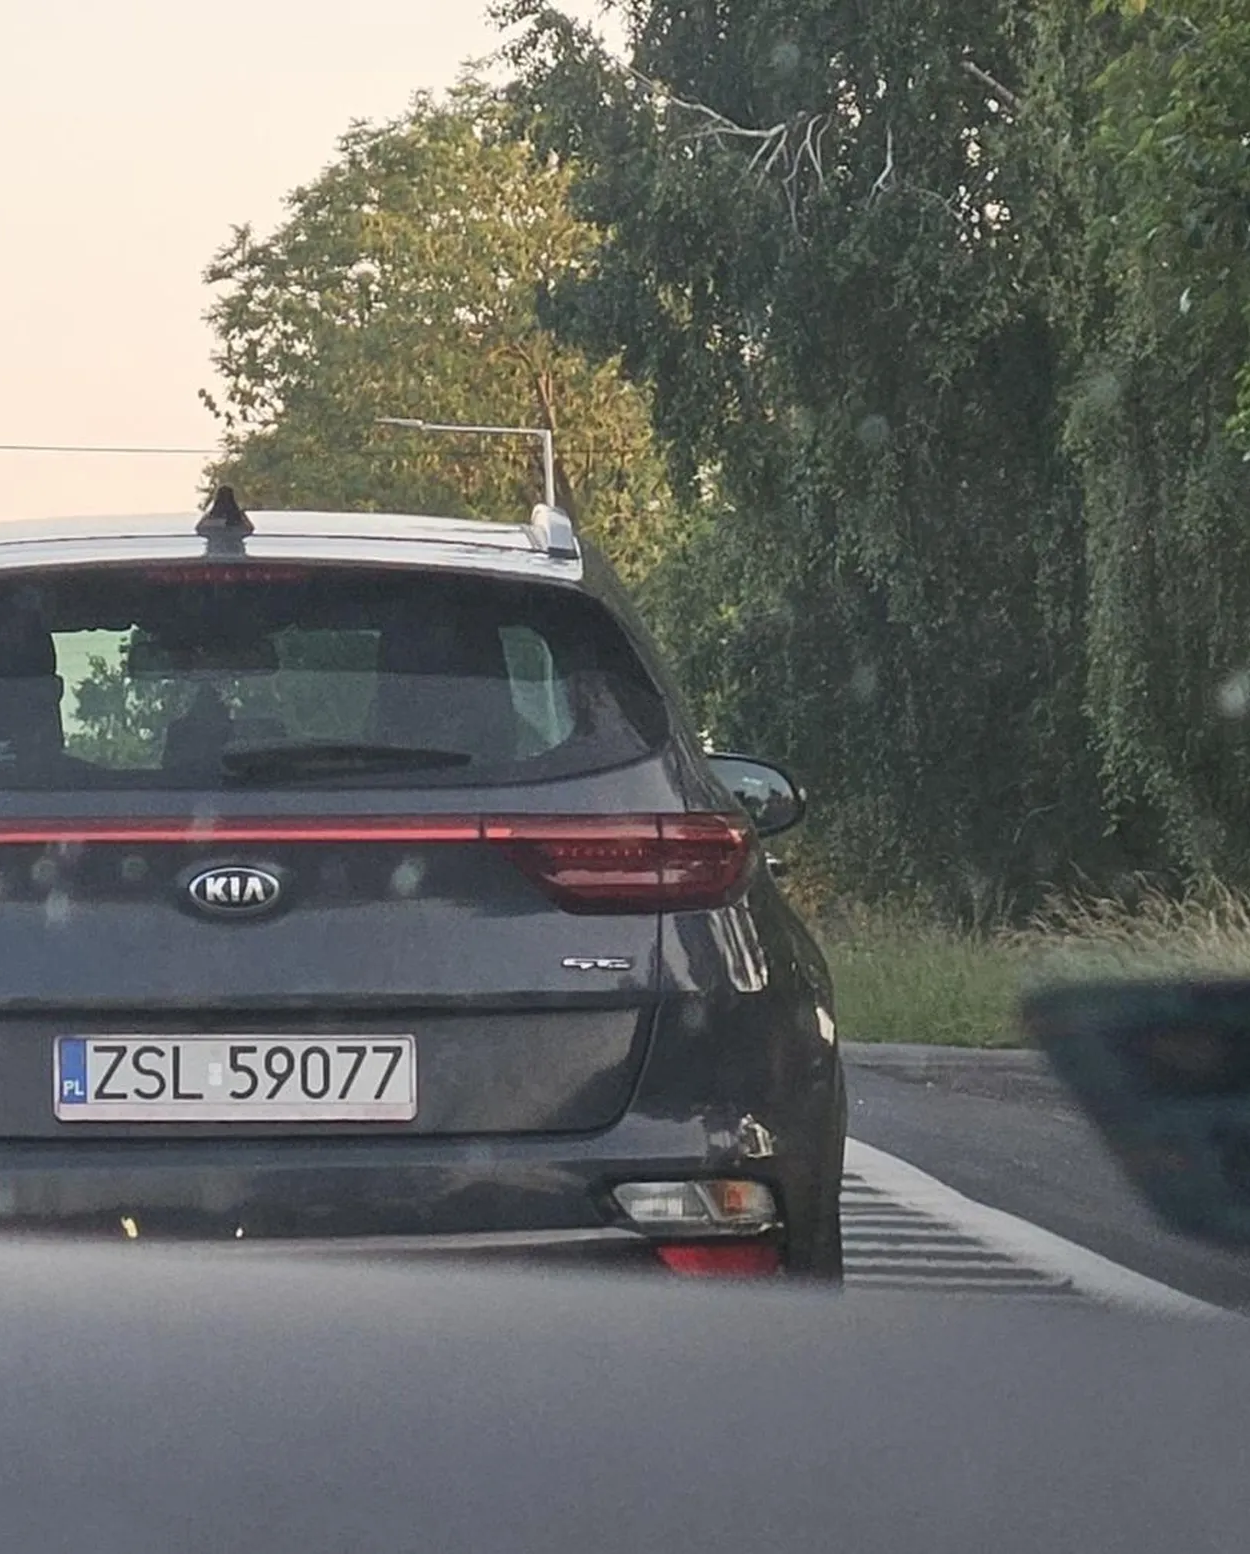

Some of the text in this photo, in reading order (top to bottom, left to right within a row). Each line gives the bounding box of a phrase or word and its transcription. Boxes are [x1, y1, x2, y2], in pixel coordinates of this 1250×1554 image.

[205, 876, 266, 903] KIA
[63, 1045, 404, 1100] PL ZSL 59077
